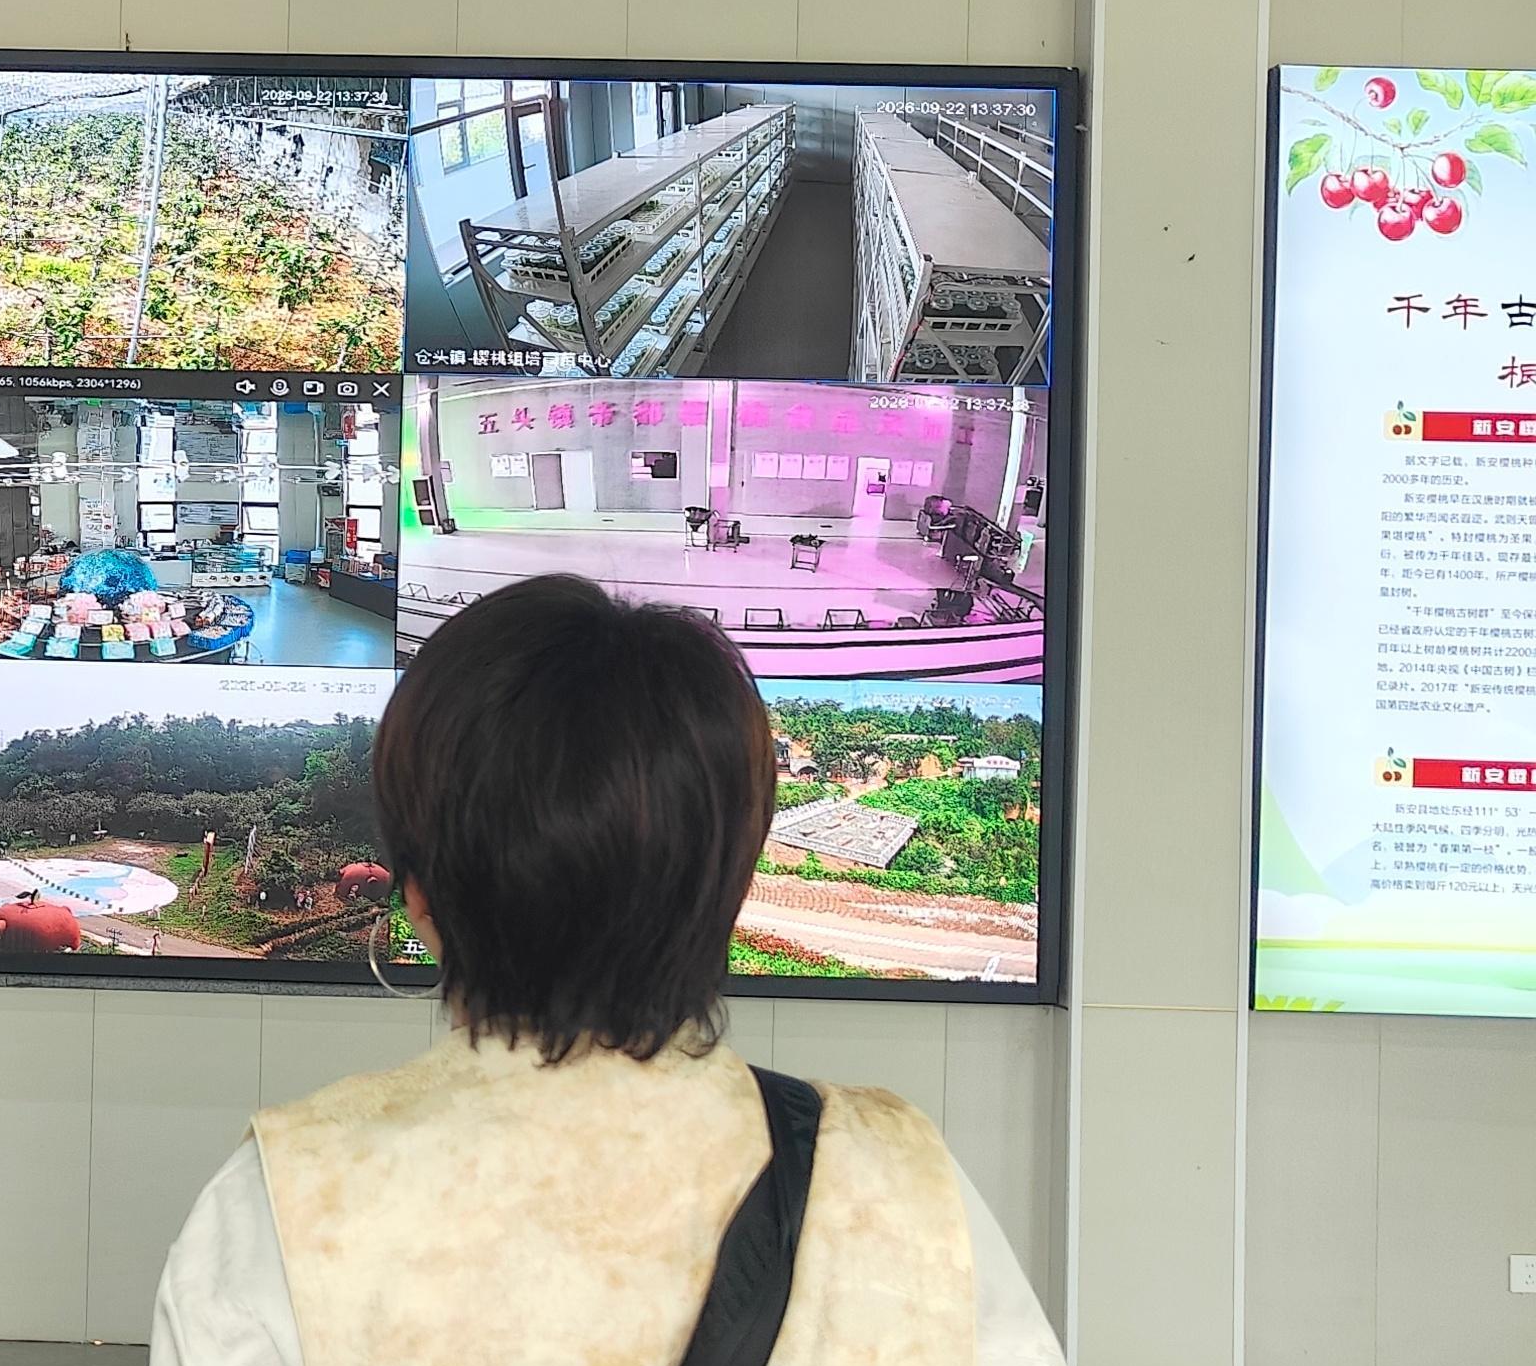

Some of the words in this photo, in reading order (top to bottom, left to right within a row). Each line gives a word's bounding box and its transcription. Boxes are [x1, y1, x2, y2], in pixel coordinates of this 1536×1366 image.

[262, 90, 333, 102] 2026-09-22
[876, 101, 966, 116] 2026-09-22
[970, 103, 1037, 117] 13:37:30
[1386, 293, 1536, 330] 千年古
